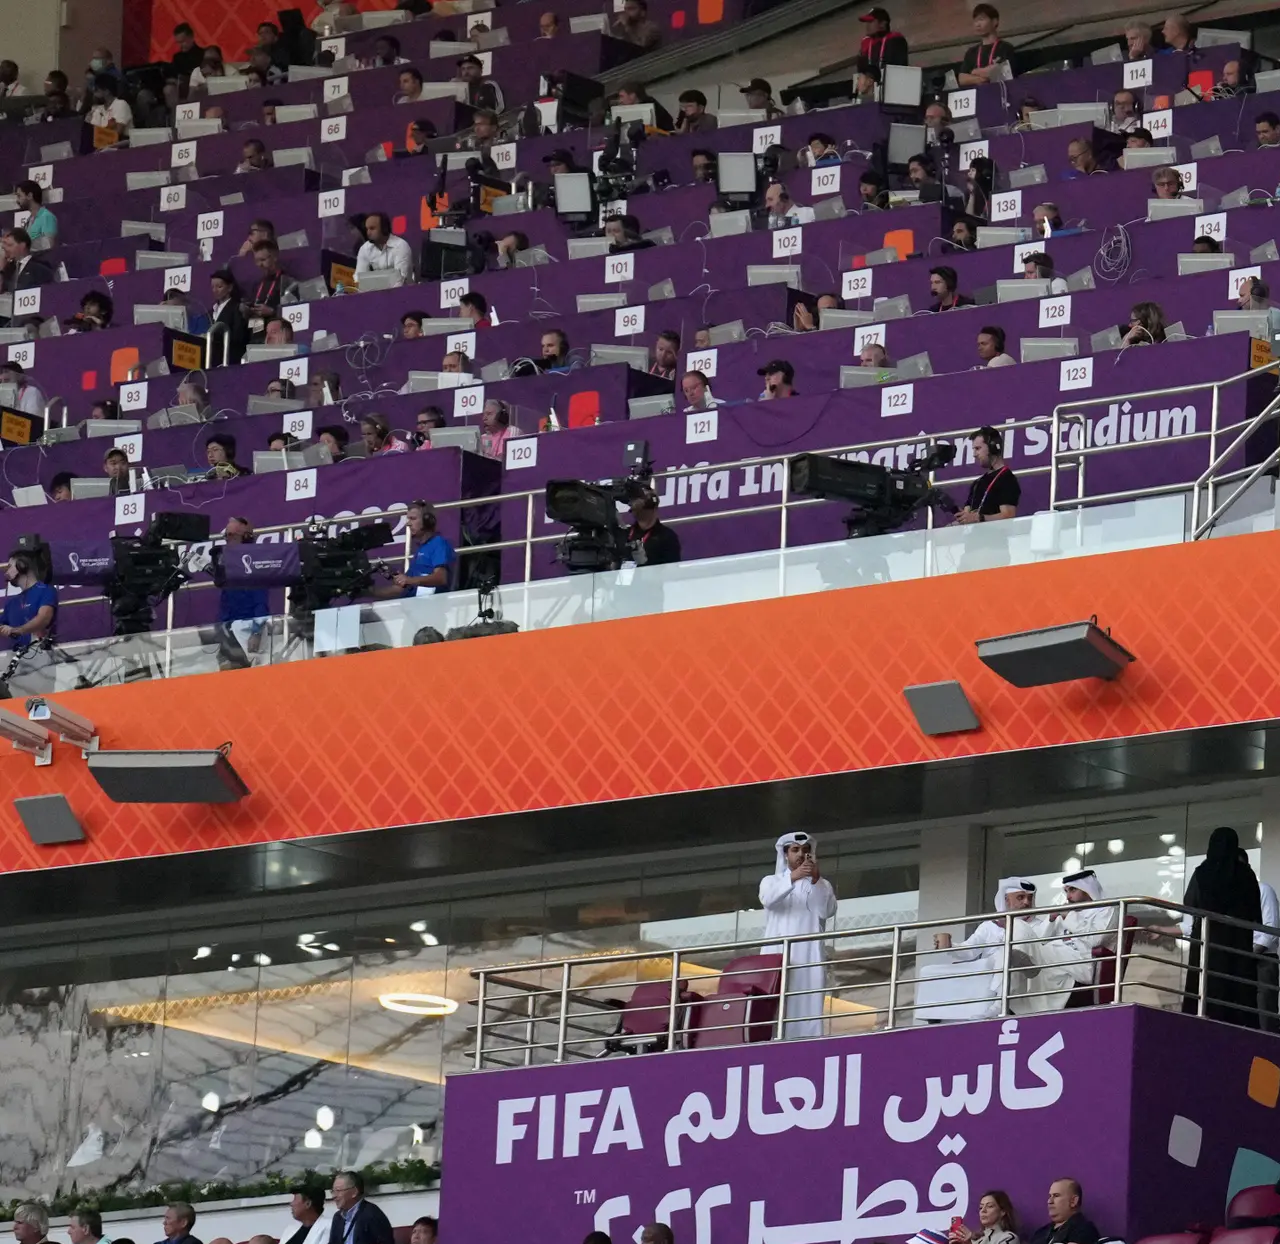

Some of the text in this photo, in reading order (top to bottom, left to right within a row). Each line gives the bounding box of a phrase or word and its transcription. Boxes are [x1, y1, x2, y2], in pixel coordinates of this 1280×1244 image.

[1130, 68, 1146, 79] 114
[331, 85, 341, 95] 71
[954, 98, 970, 109] 113
[182, 110, 194, 119] 70
[327, 124, 340, 135] 66
[1147, 118, 1167, 131] 144
[759, 134, 775, 144] 112
[177, 149, 190, 160] 65
[496, 151, 511, 163] 116
[965, 149, 984, 160] 108
[817, 175, 835, 186] 107
[167, 192, 179, 203] 60
[324, 197, 339, 208] 110
[996, 200, 1016, 212] 138
[202, 219, 219, 230] 109
[1199, 222, 1220, 234] 134
[778, 236, 797, 248] 102
[610, 262, 628, 273] 101
[168, 274, 187, 286] 104
[848, 278, 867, 289] 132
[444, 287, 464, 298] 100
[19, 295, 37, 306] 103
[1045, 305, 1065, 317] 128
[289, 312, 302, 323] 99
[623, 315, 638, 326] 96
[861, 333, 879, 345] 127
[454, 341, 468, 352] 95
[15, 351, 28, 362] 98
[693, 358, 711, 370] 126
[287, 367, 301, 378] 94
[1066, 368, 1086, 380] 123
[127, 391, 140, 403] 93
[461, 395, 476, 407] 90
[888, 394, 907, 406] 122
[291, 420, 305, 432] 89
[694, 420, 711, 433] 121
[511, 447, 531, 459] 120
[294, 479, 309, 491] 84
[123, 503, 137, 515] 83
[495, 1019, 1065, 1167] كأس العالم FIFA
